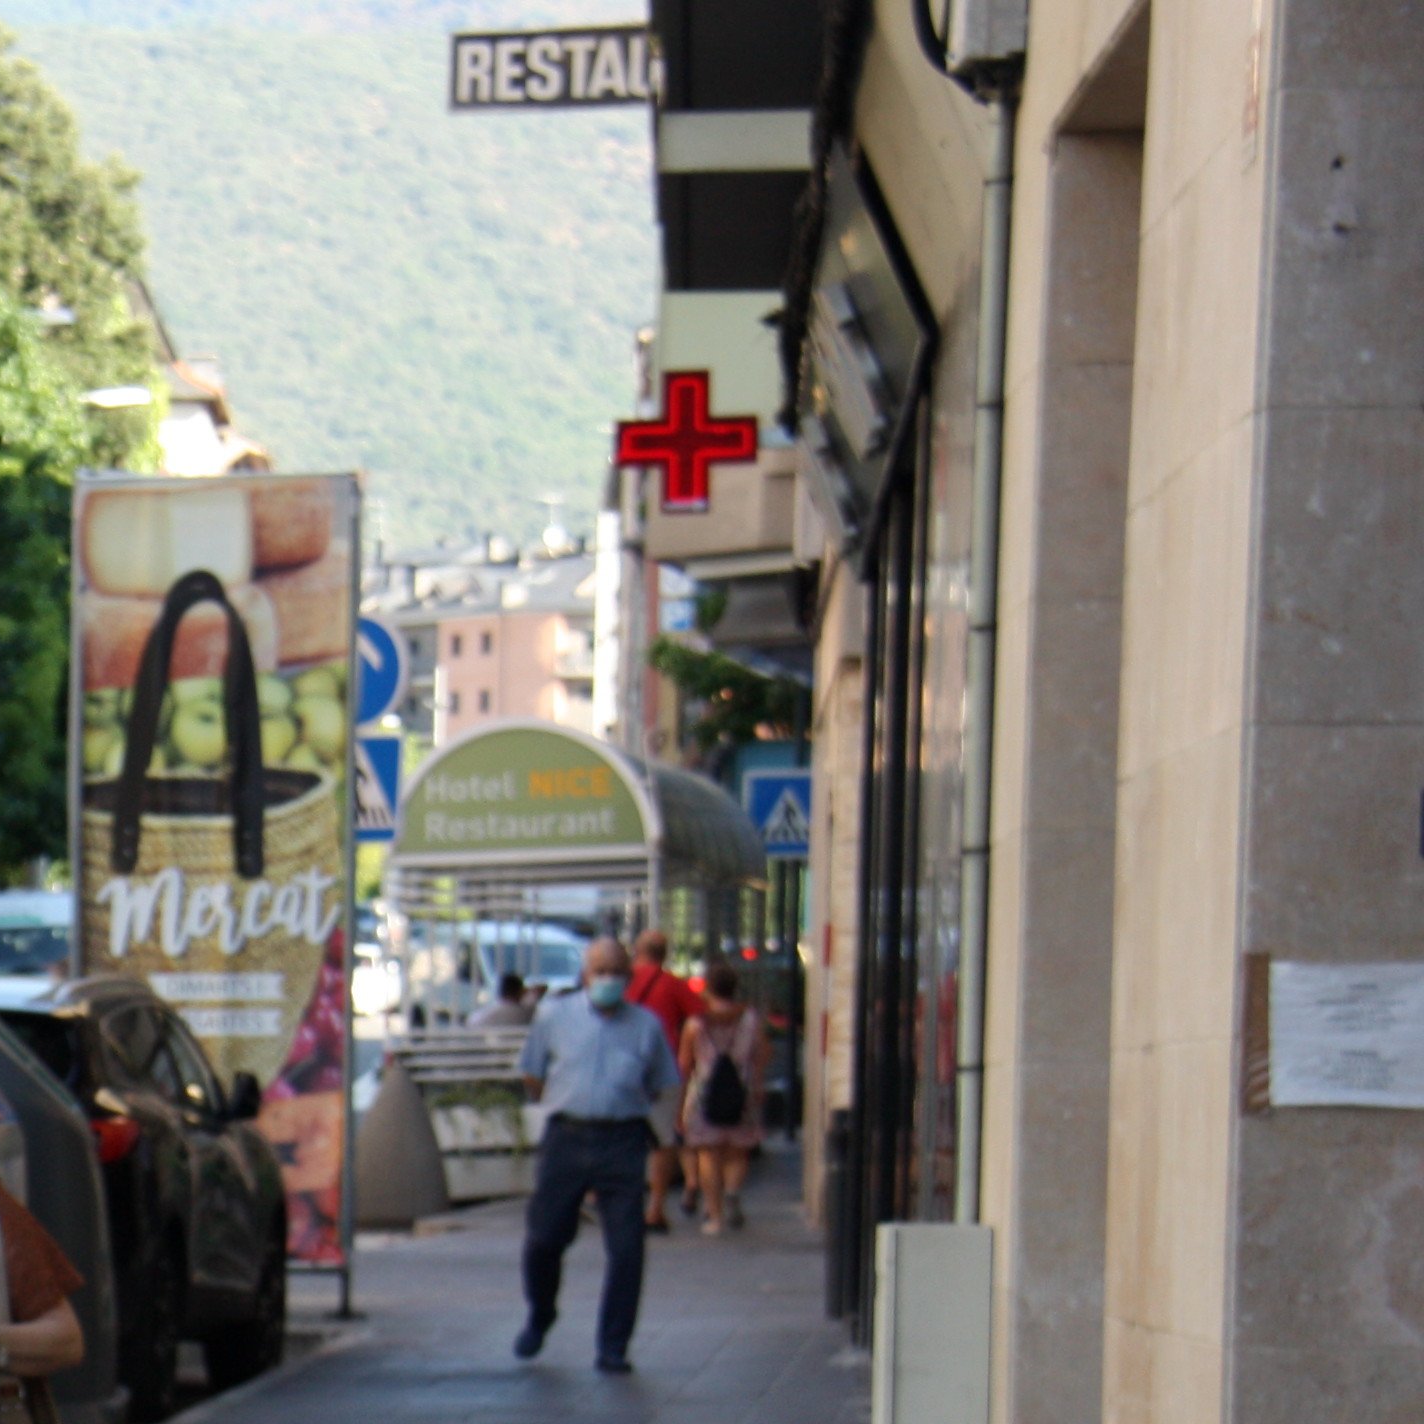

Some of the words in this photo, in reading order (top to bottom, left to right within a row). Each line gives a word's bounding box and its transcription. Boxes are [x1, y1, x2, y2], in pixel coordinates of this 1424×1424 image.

[425, 769, 517, 803] Hotel
[527, 765, 614, 799] NICE
[424, 806, 617, 842] Restaurant
[95, 864, 342, 958] Mercat
